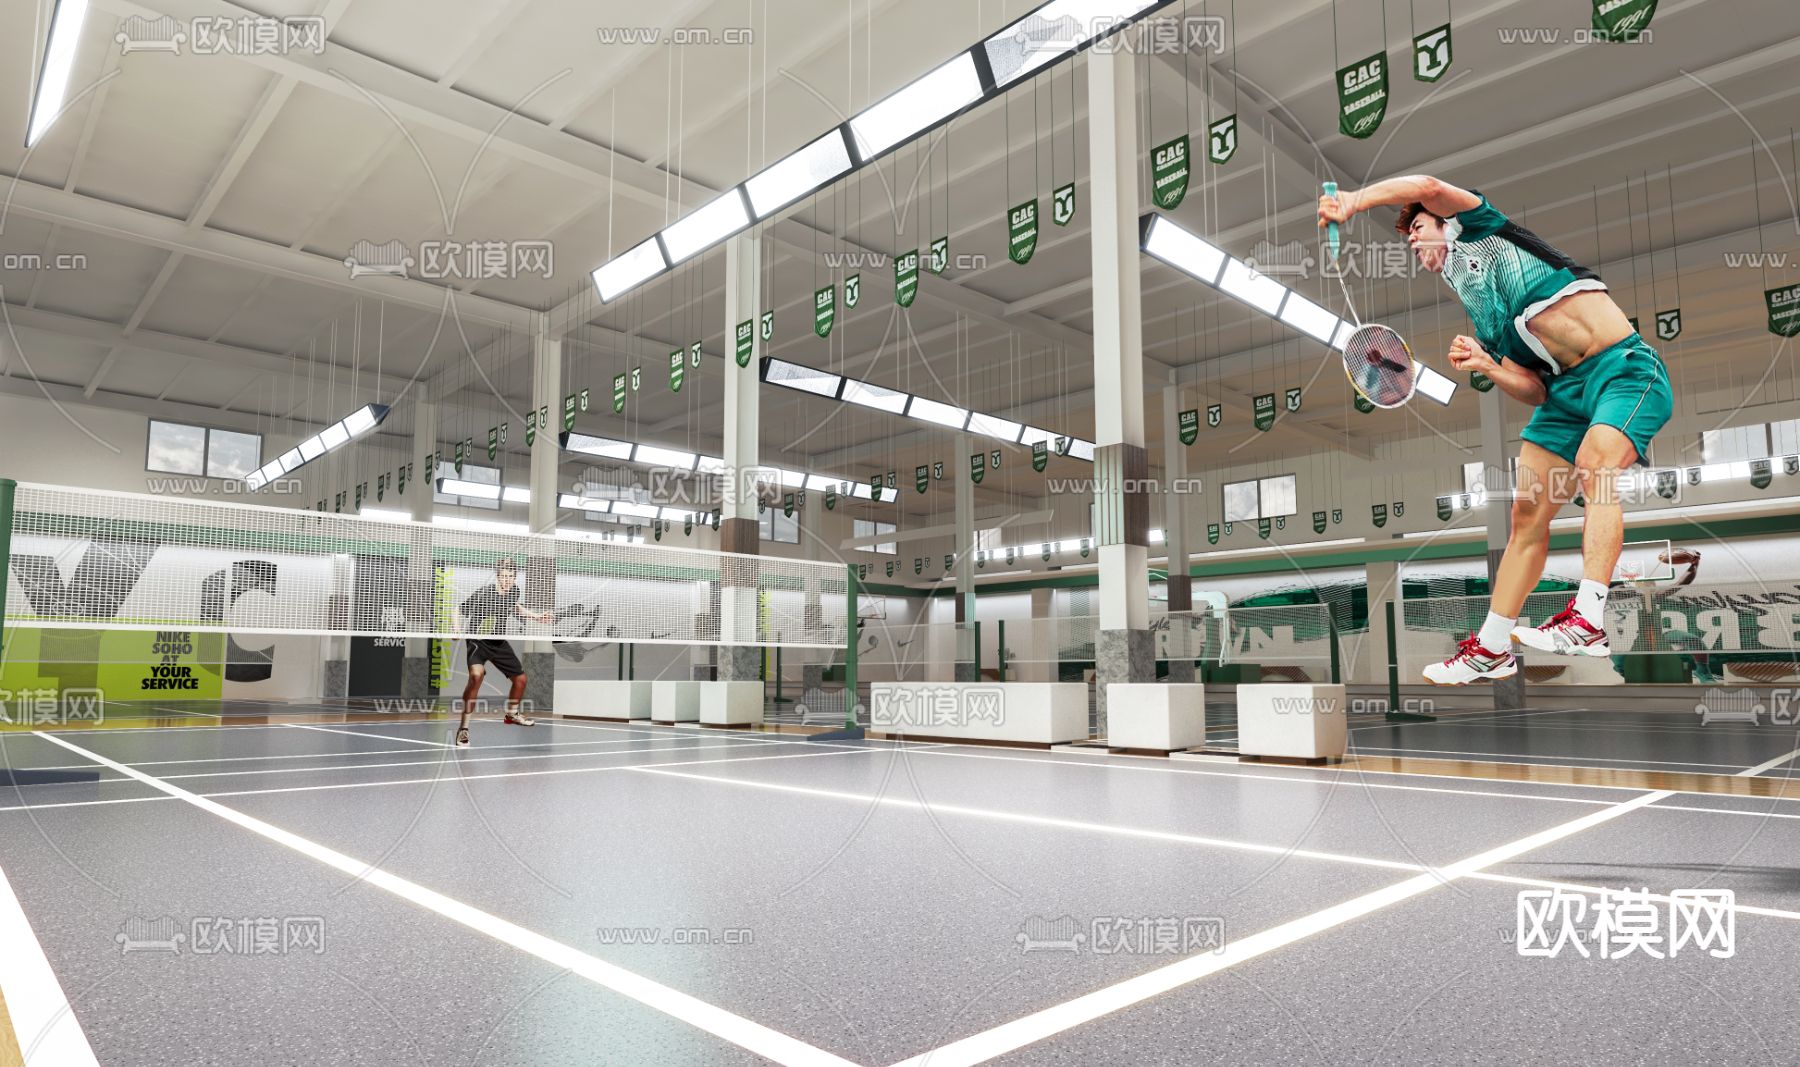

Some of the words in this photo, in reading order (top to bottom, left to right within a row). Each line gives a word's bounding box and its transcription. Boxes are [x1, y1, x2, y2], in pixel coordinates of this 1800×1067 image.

[1343, 60, 1381, 88] CAC
[1343, 89, 1386, 115] BASEBALL
[1155, 141, 1185, 165] CAC
[1156, 167, 1188, 189] BASEBALL
[1012, 204, 1034, 225] CAC
[897, 254, 916, 272] CAC
[817, 289, 833, 304] CAC
[738, 323, 751, 337] CAC
[1256, 397, 1273, 407] CAC
[1181, 412, 1196, 423] CAC
[156, 631, 191, 642] NIKE
[373, 637, 405, 647] SERVIC
[152, 643, 193, 654] SOHO
[150, 666, 191, 677] YOUR
[141, 678, 199, 689] SERVICE
